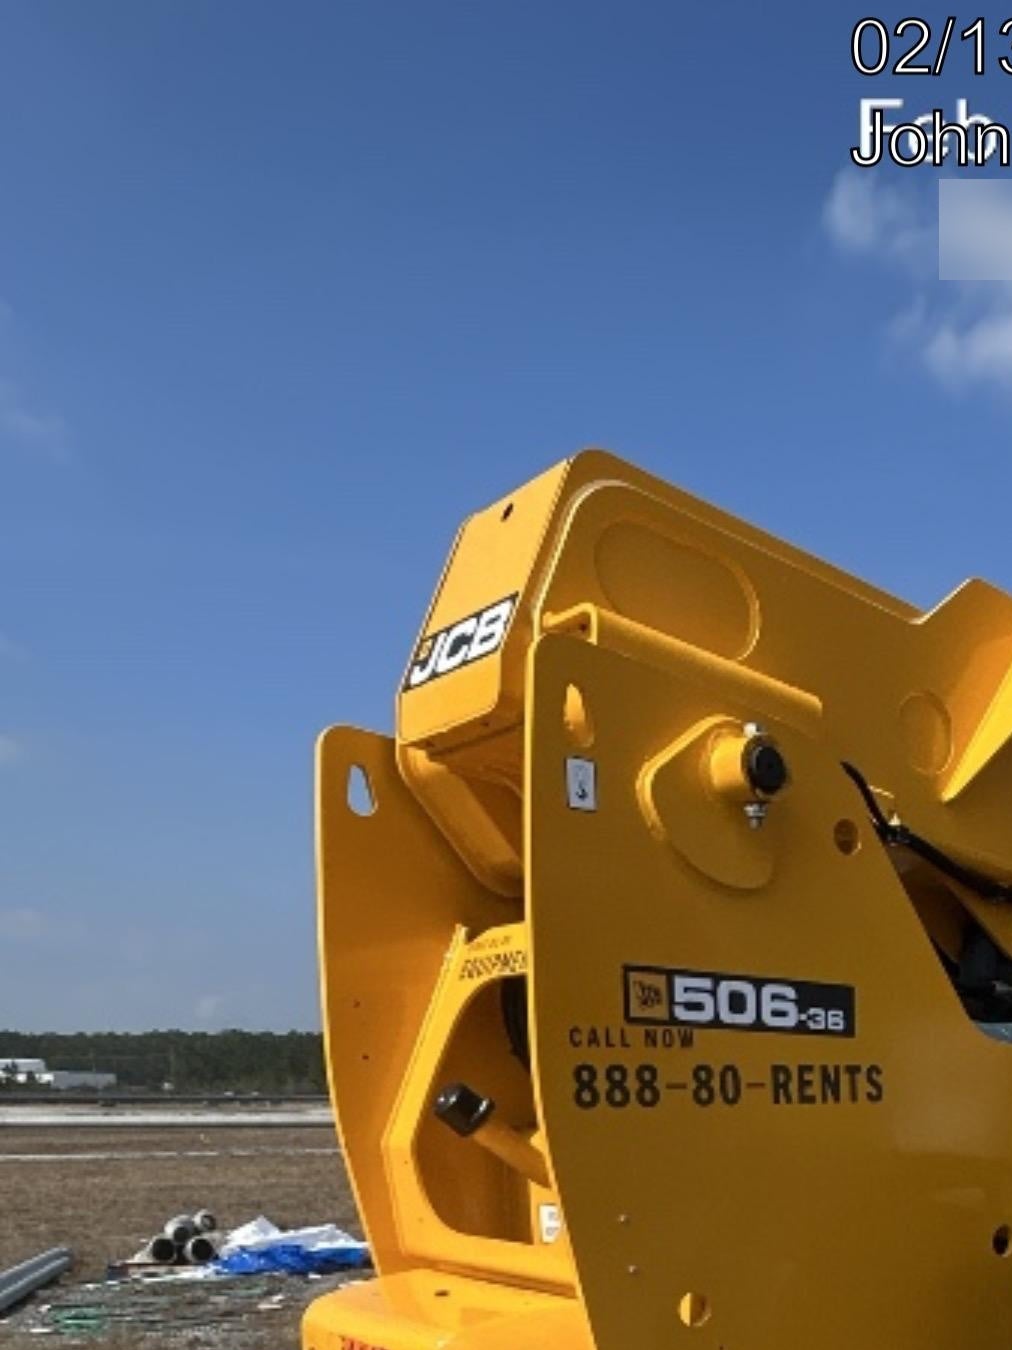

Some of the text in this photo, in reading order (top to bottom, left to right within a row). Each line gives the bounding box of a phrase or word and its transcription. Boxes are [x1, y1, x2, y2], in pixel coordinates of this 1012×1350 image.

[409, 600, 514, 687] JCB
[569, 1027, 694, 1048] CALL NOW
[573, 1063, 884, 1109] 888-80-RENTS
